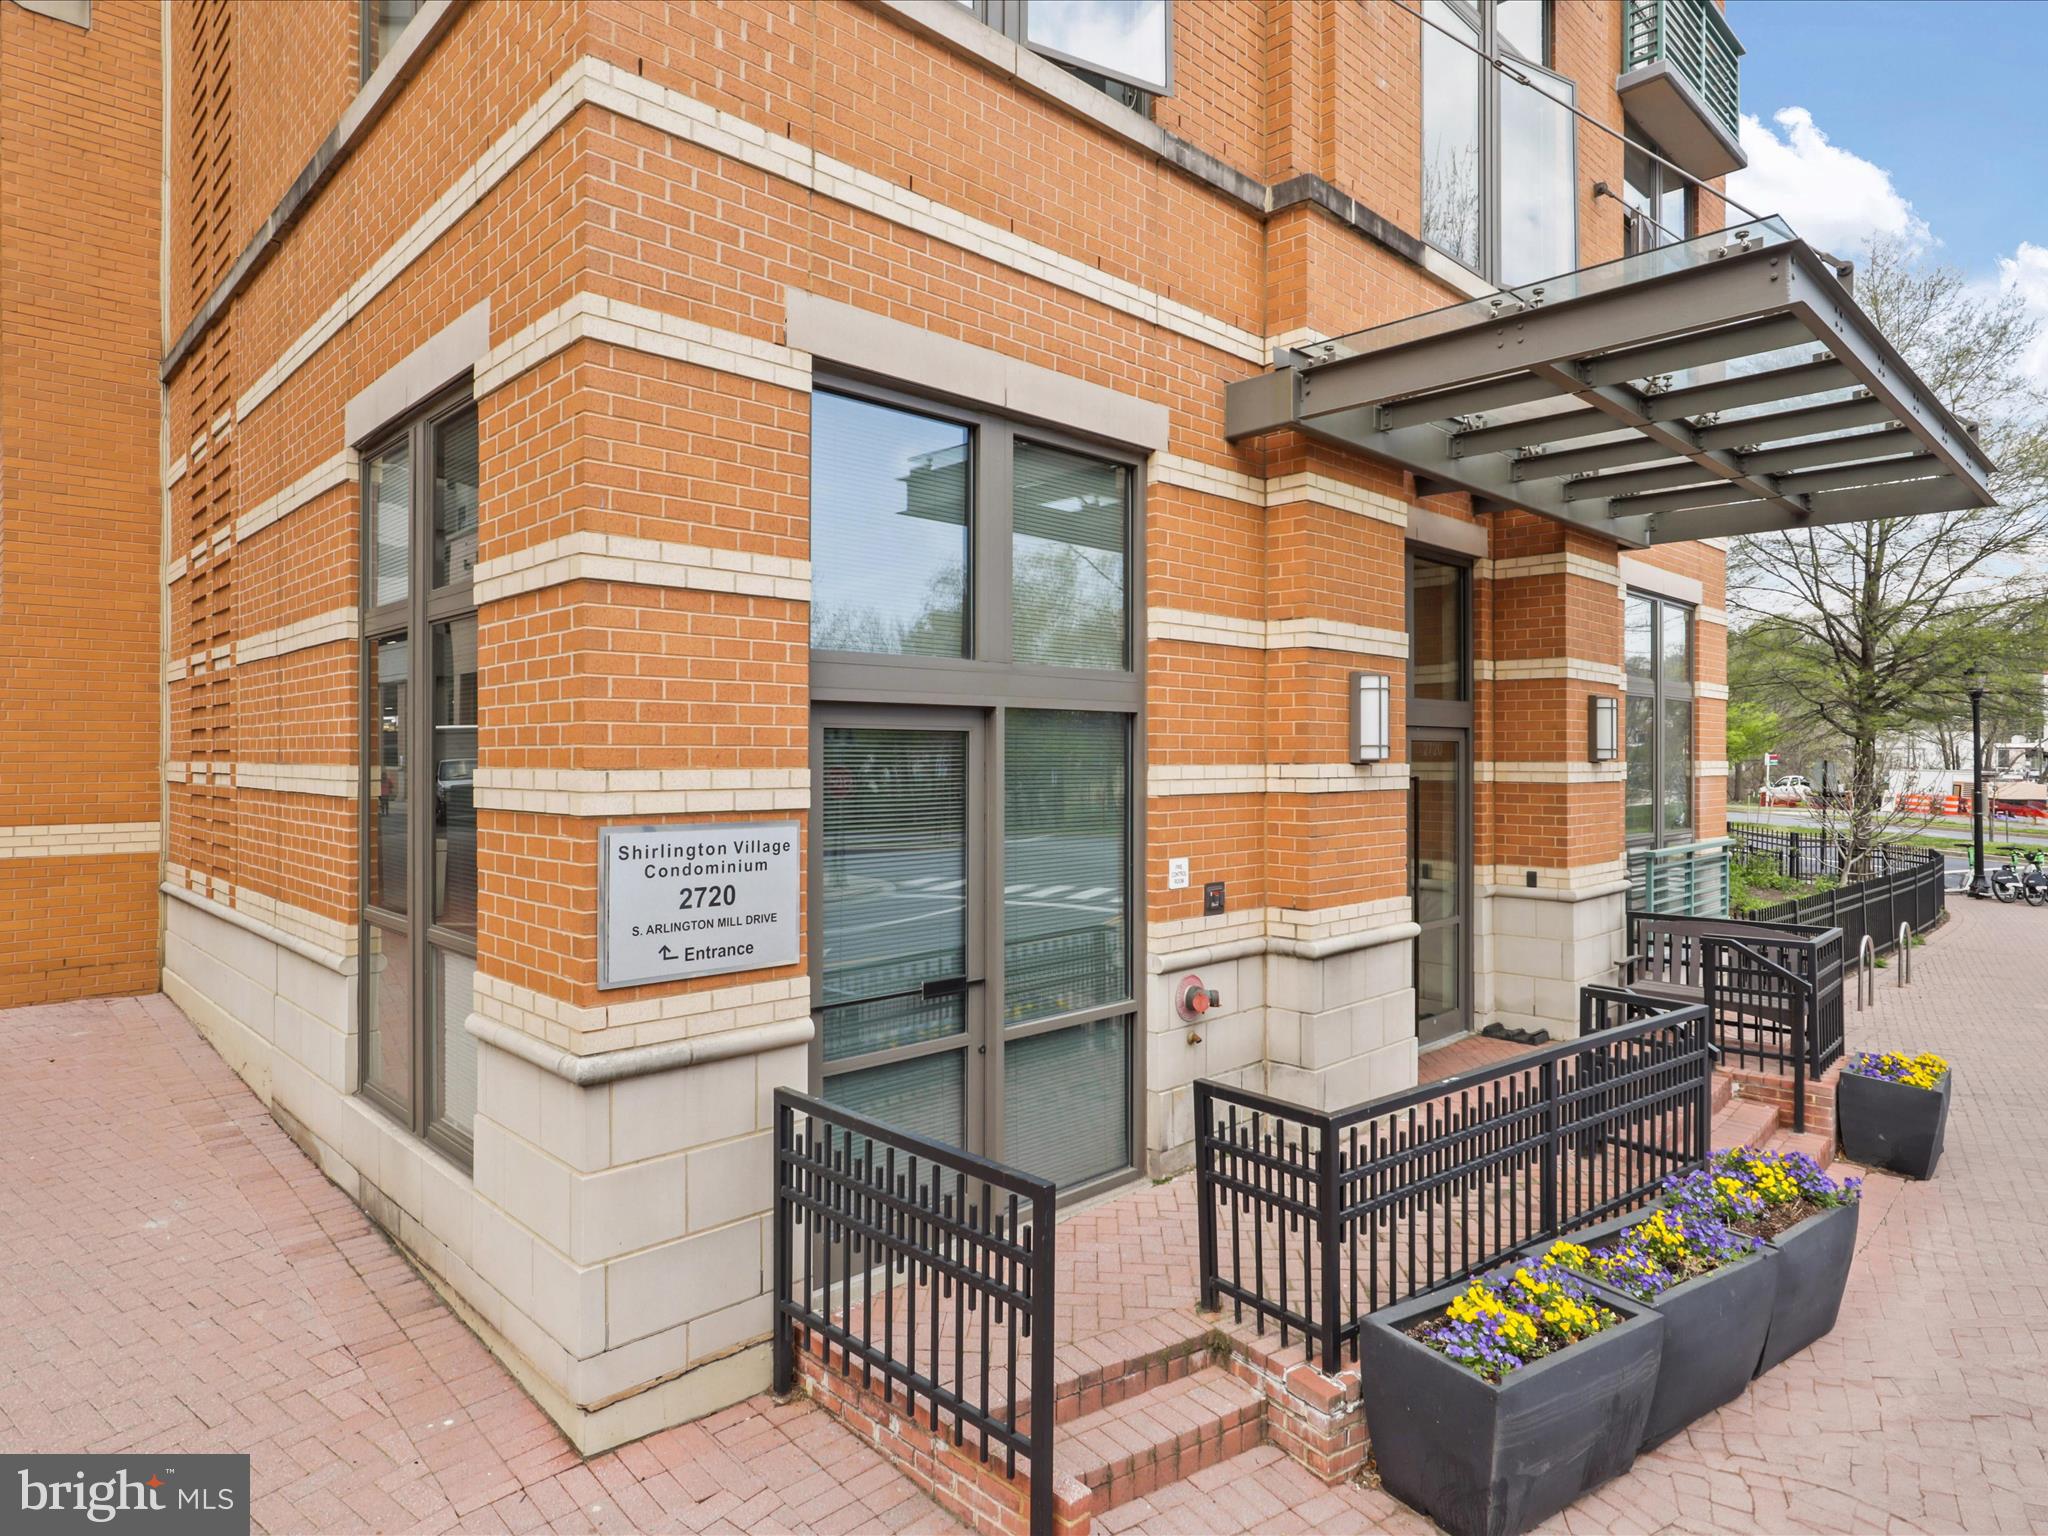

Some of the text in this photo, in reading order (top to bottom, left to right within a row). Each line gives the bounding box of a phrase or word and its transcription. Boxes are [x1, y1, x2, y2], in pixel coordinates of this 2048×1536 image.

[618, 840, 791, 861] Shirlington Village
[644, 860, 768, 879] Condominium
[679, 884, 736, 910] 2720
[632, 912, 778, 937] S. ARLINGTON MILL DRIVE
[684, 943, 754, 962] Entrance
